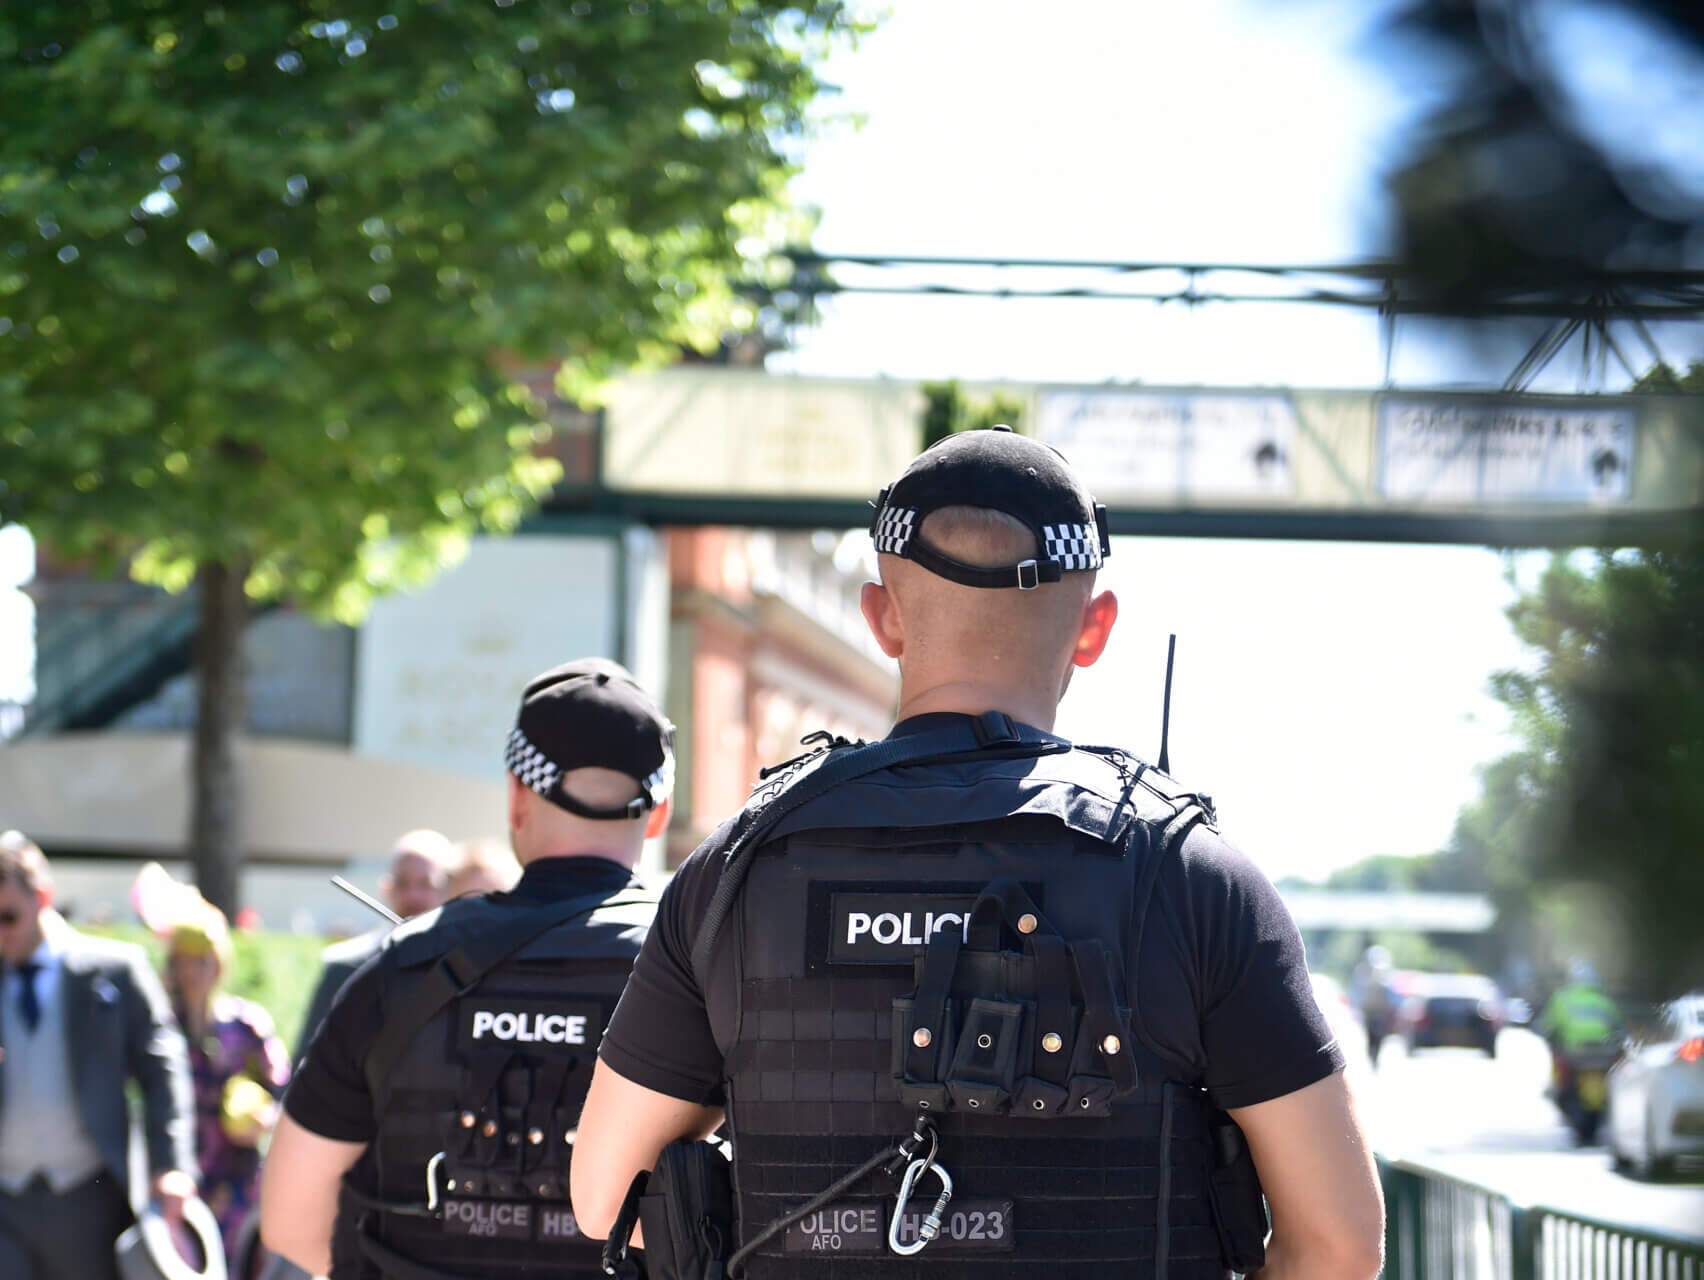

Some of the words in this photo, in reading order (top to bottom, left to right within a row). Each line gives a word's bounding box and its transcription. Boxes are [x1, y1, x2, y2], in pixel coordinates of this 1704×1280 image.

[846, 912, 972, 945] POLIC
[472, 1011, 587, 1044] POLICE
[444, 1201, 529, 1226] POLICE
[811, 1234, 842, 1250] AFO
